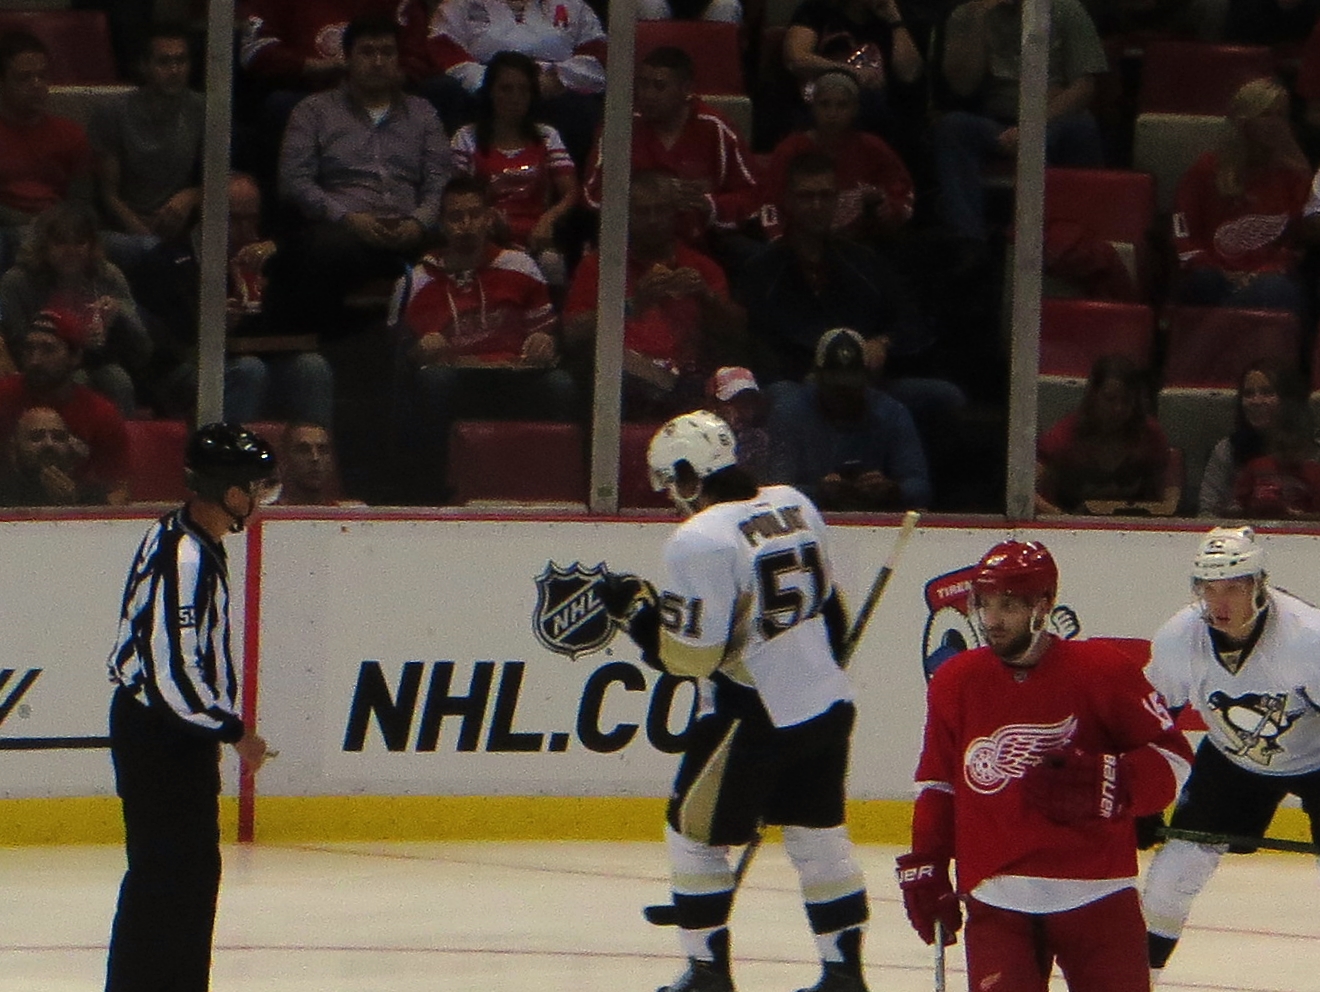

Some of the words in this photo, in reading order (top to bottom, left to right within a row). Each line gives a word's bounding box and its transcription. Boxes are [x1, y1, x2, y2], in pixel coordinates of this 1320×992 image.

[552, 589, 602, 636] NHL
[660, 590, 702, 639] 51
[755, 541, 826, 642] 51
[342, 661, 702, 753] NHL.CO
